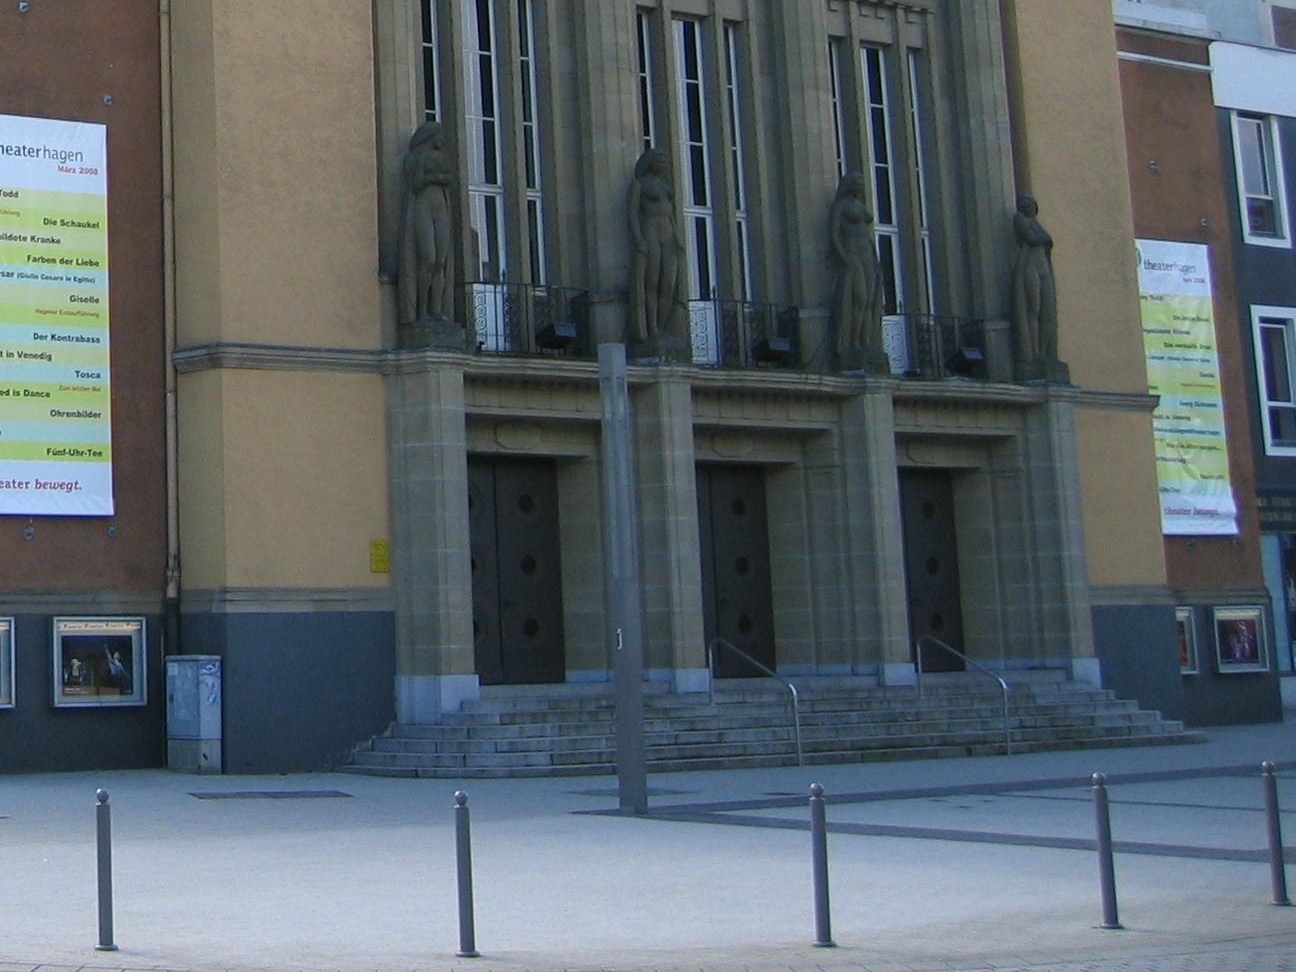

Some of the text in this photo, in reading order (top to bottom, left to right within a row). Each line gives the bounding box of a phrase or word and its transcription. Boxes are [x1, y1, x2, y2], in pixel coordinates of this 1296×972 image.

[58, 165, 76, 174] März
[43, 218, 100, 228] Die Schaukel
[30, 234, 61, 244] Kranke
[26, 254, 100, 267] Farben der Liebe
[70, 294, 100, 304] Giselle
[33, 332, 100, 344] Der Kontrabass
[6, 350, 14, 358] in
[17, 352, 52, 362] Venedig
[75, 370, 101, 378] Tosca
[12, 388, 20, 397] is
[23, 388, 50, 398] Dance
[50, 409, 102, 419] Ohrenbilder
[46, 448, 102, 458] Fünf-Uhr-Tee
[34, 478, 82, 493] bewegt.
